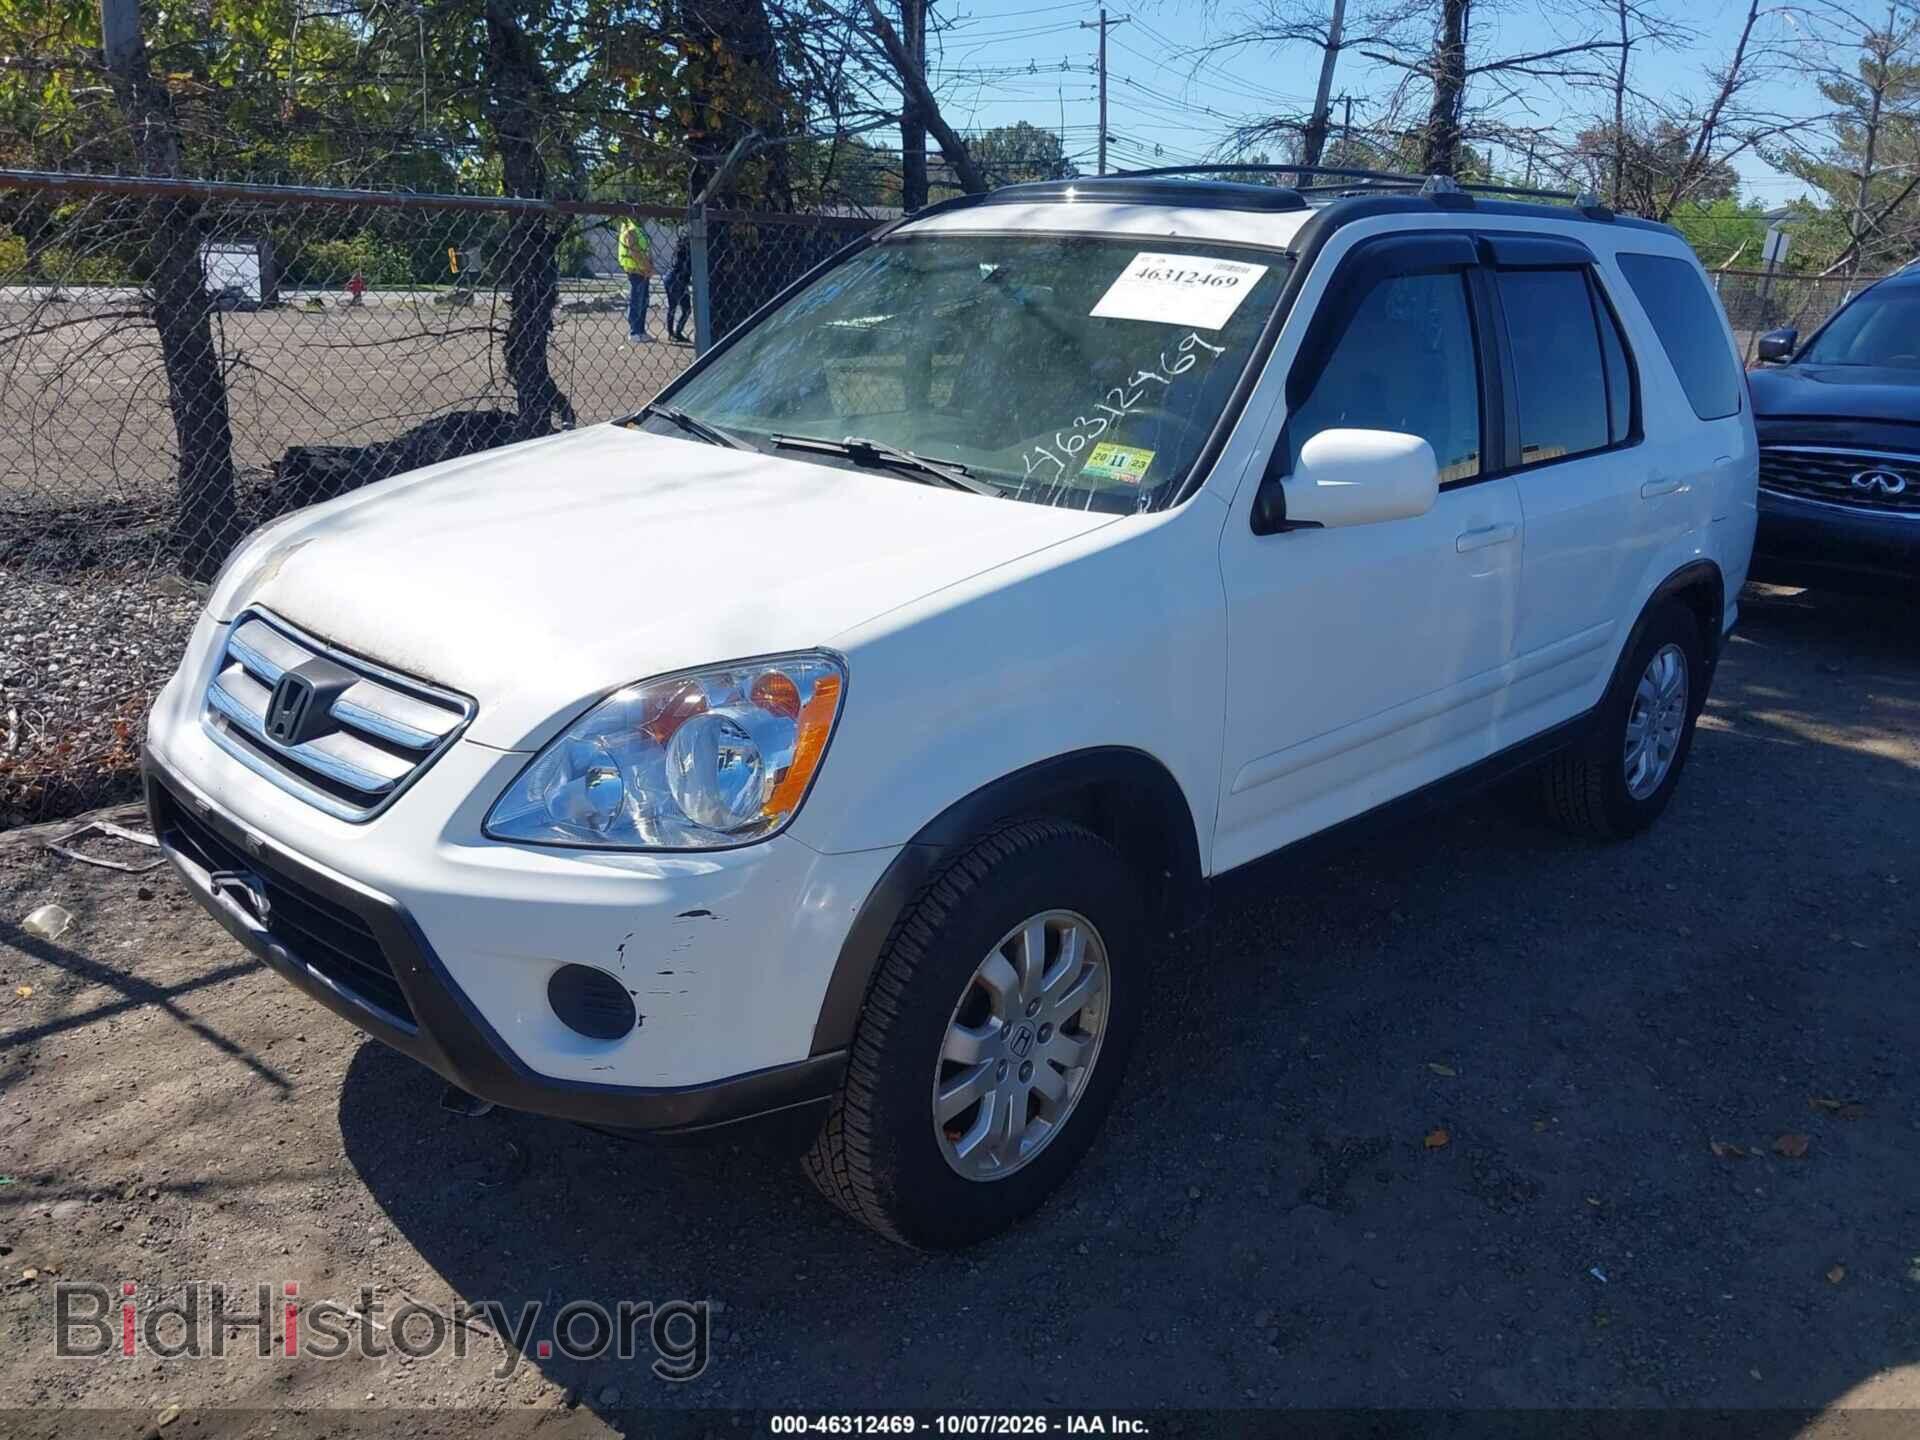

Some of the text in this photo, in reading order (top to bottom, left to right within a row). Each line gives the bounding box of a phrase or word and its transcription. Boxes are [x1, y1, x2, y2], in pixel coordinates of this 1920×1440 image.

[1135, 267, 1239, 288] 46312469
[1093, 452, 1147, 470] 20 11 23
